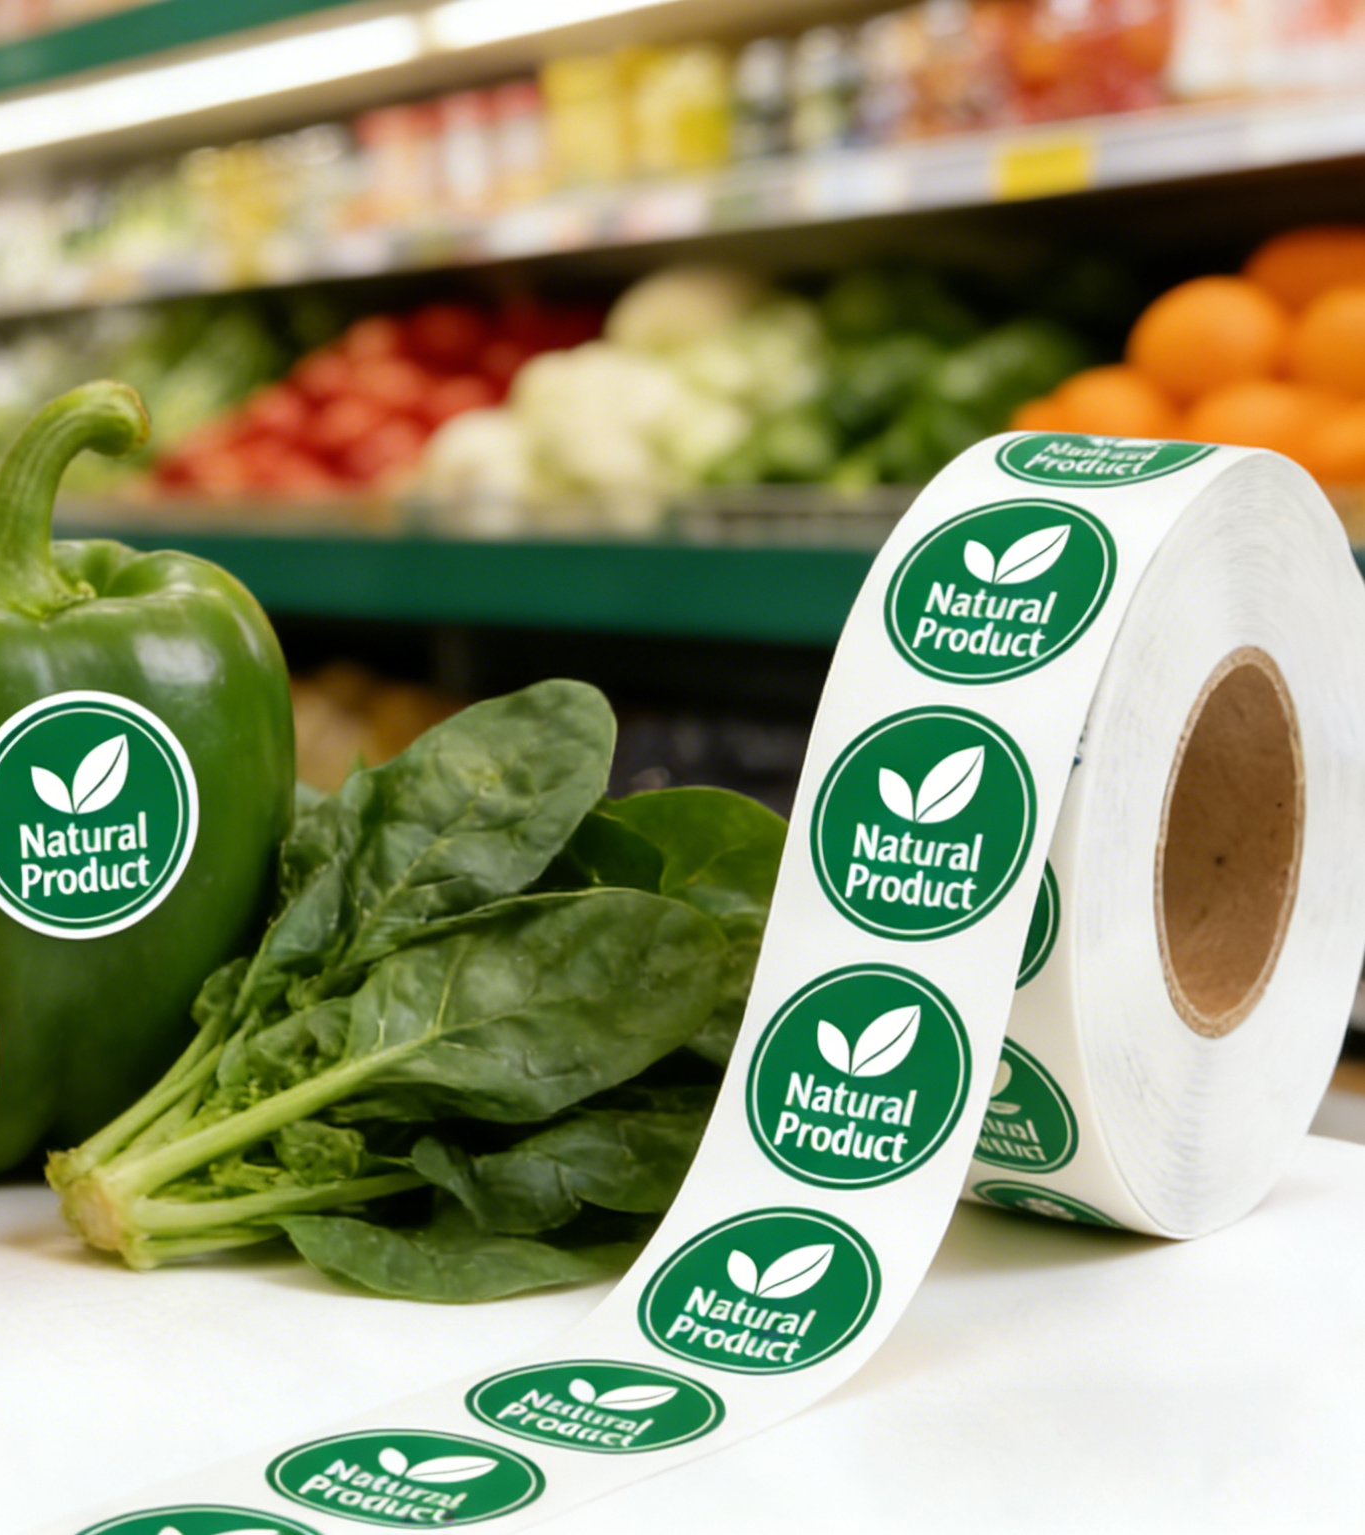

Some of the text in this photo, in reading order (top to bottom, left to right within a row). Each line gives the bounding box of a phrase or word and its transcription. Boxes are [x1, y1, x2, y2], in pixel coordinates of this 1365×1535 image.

[924, 581, 1058, 625] Natural
[911, 616, 1047, 658] Product
[19, 811, 148, 858] Natural
[852, 822, 984, 873] Natural
[20, 855, 150, 900] Product
[844, 862, 978, 911] Product
[784, 1071, 918, 1127] Natural
[773, 1111, 908, 1165] Product
[684, 1286, 817, 1337] Natural
[665, 1314, 802, 1364] Product
